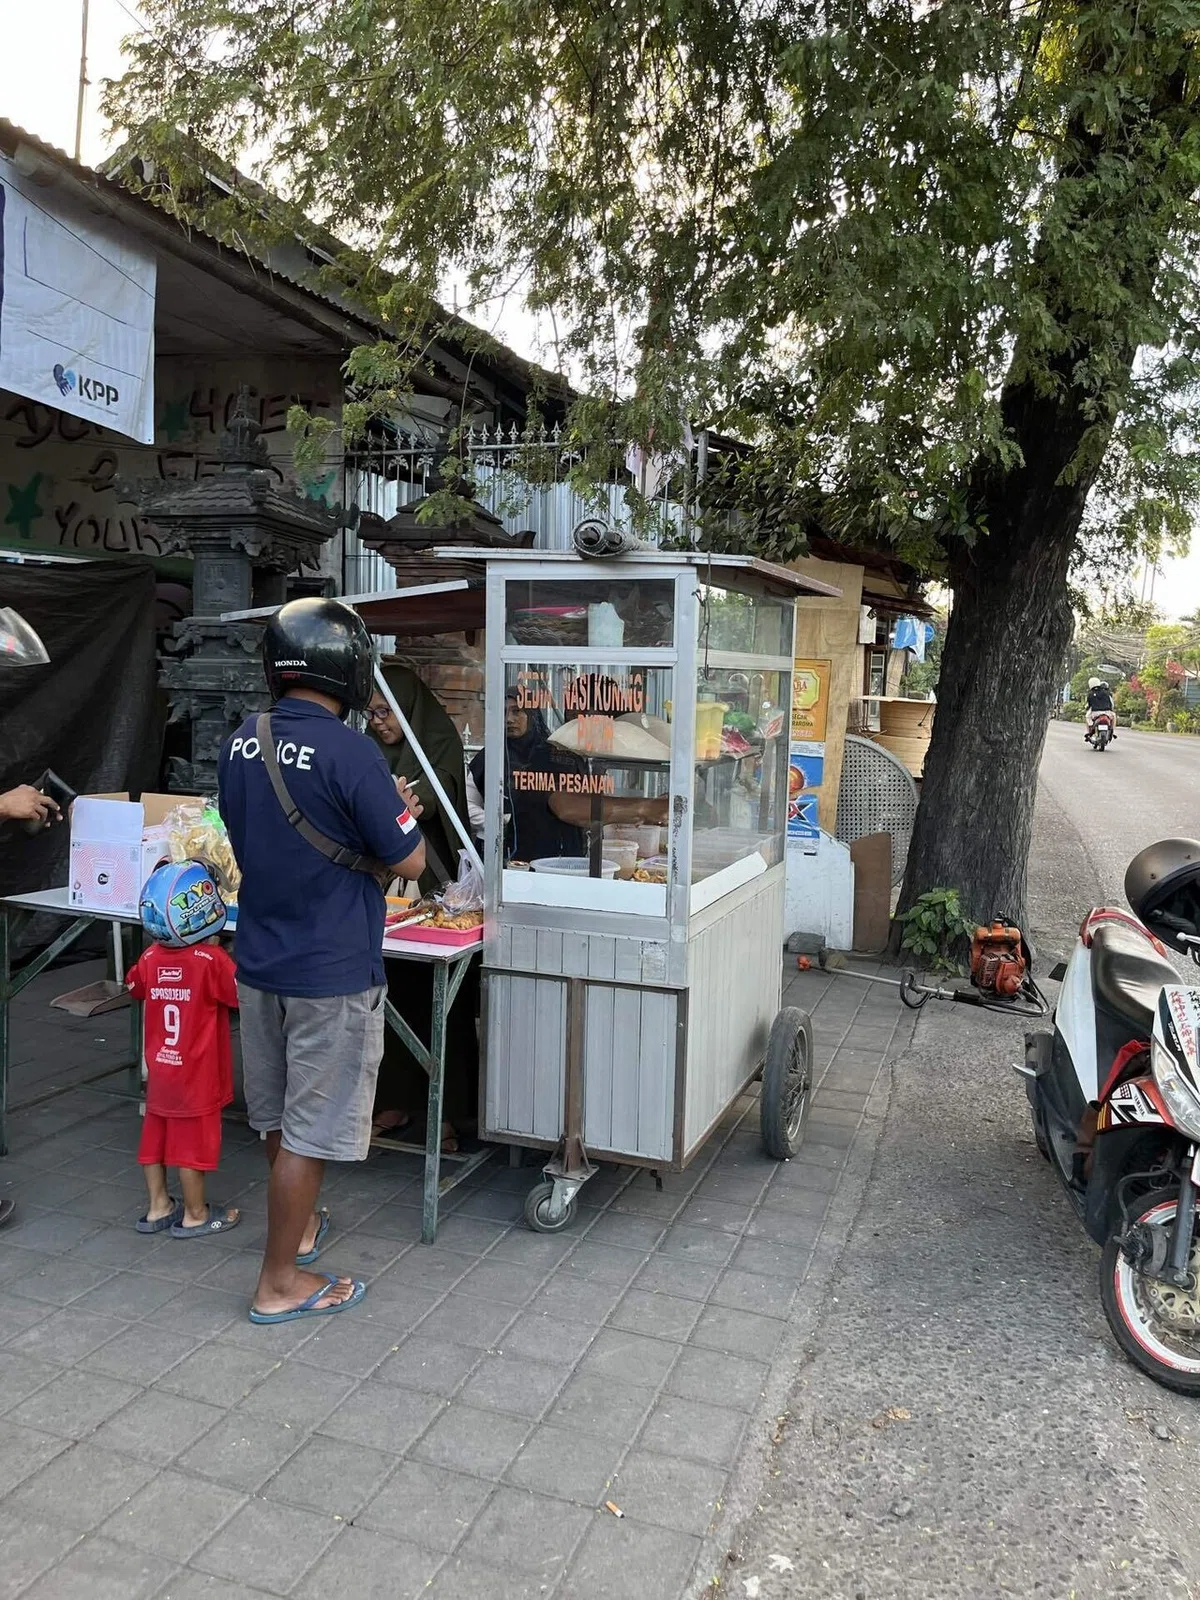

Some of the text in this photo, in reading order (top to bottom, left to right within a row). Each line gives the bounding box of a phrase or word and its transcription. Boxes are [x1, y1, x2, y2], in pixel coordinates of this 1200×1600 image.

[78, 373, 119, 407] KPP
[274, 659, 308, 668] HONDA
[563, 672, 590, 710] NASI
[594, 672, 643, 712] KUNING
[229, 737, 315, 770] POICE
[513, 770, 615, 794] TERIMA PESANAN
[170, 880, 213, 910] TAYO
[163, 1003, 180, 1046] 9
